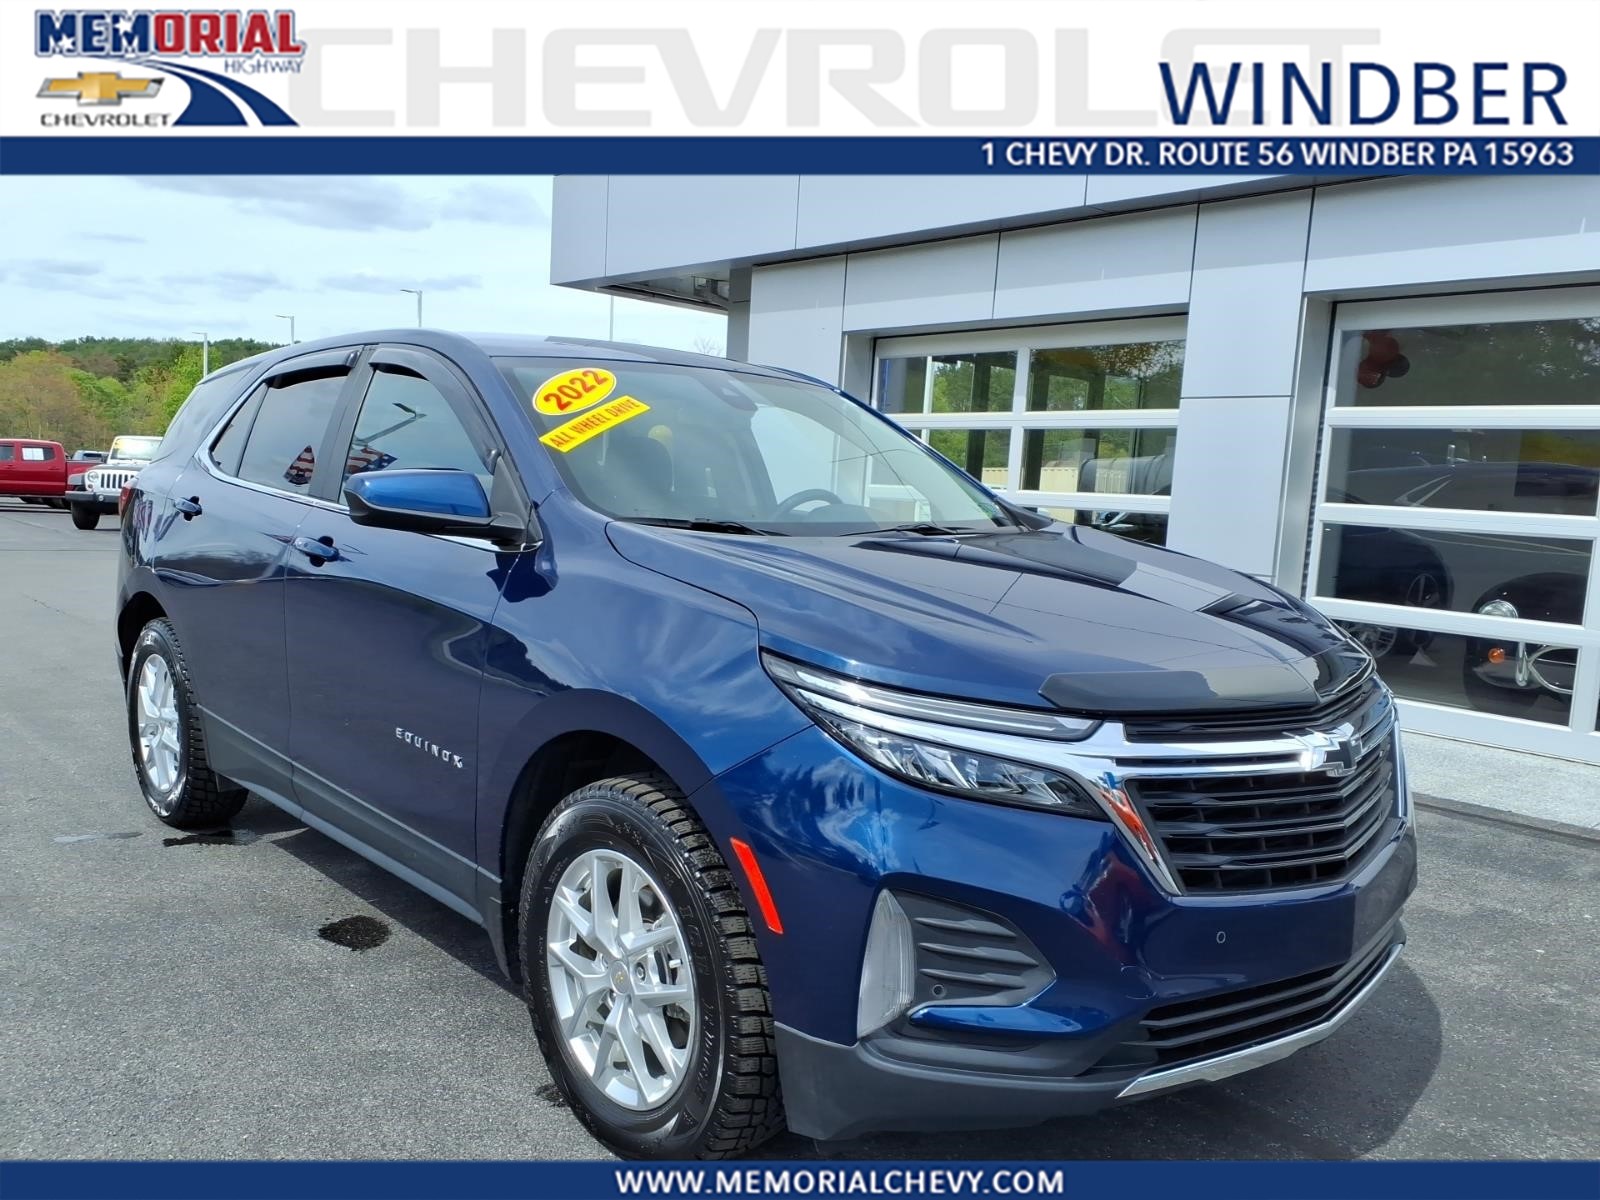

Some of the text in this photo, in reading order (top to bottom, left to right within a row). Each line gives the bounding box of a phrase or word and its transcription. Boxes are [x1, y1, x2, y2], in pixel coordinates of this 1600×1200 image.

[543, 369, 609, 411] 2022
[550, 398, 641, 448] ALL WHEEL DRIVE
[395, 727, 463, 768] EQUINOX
